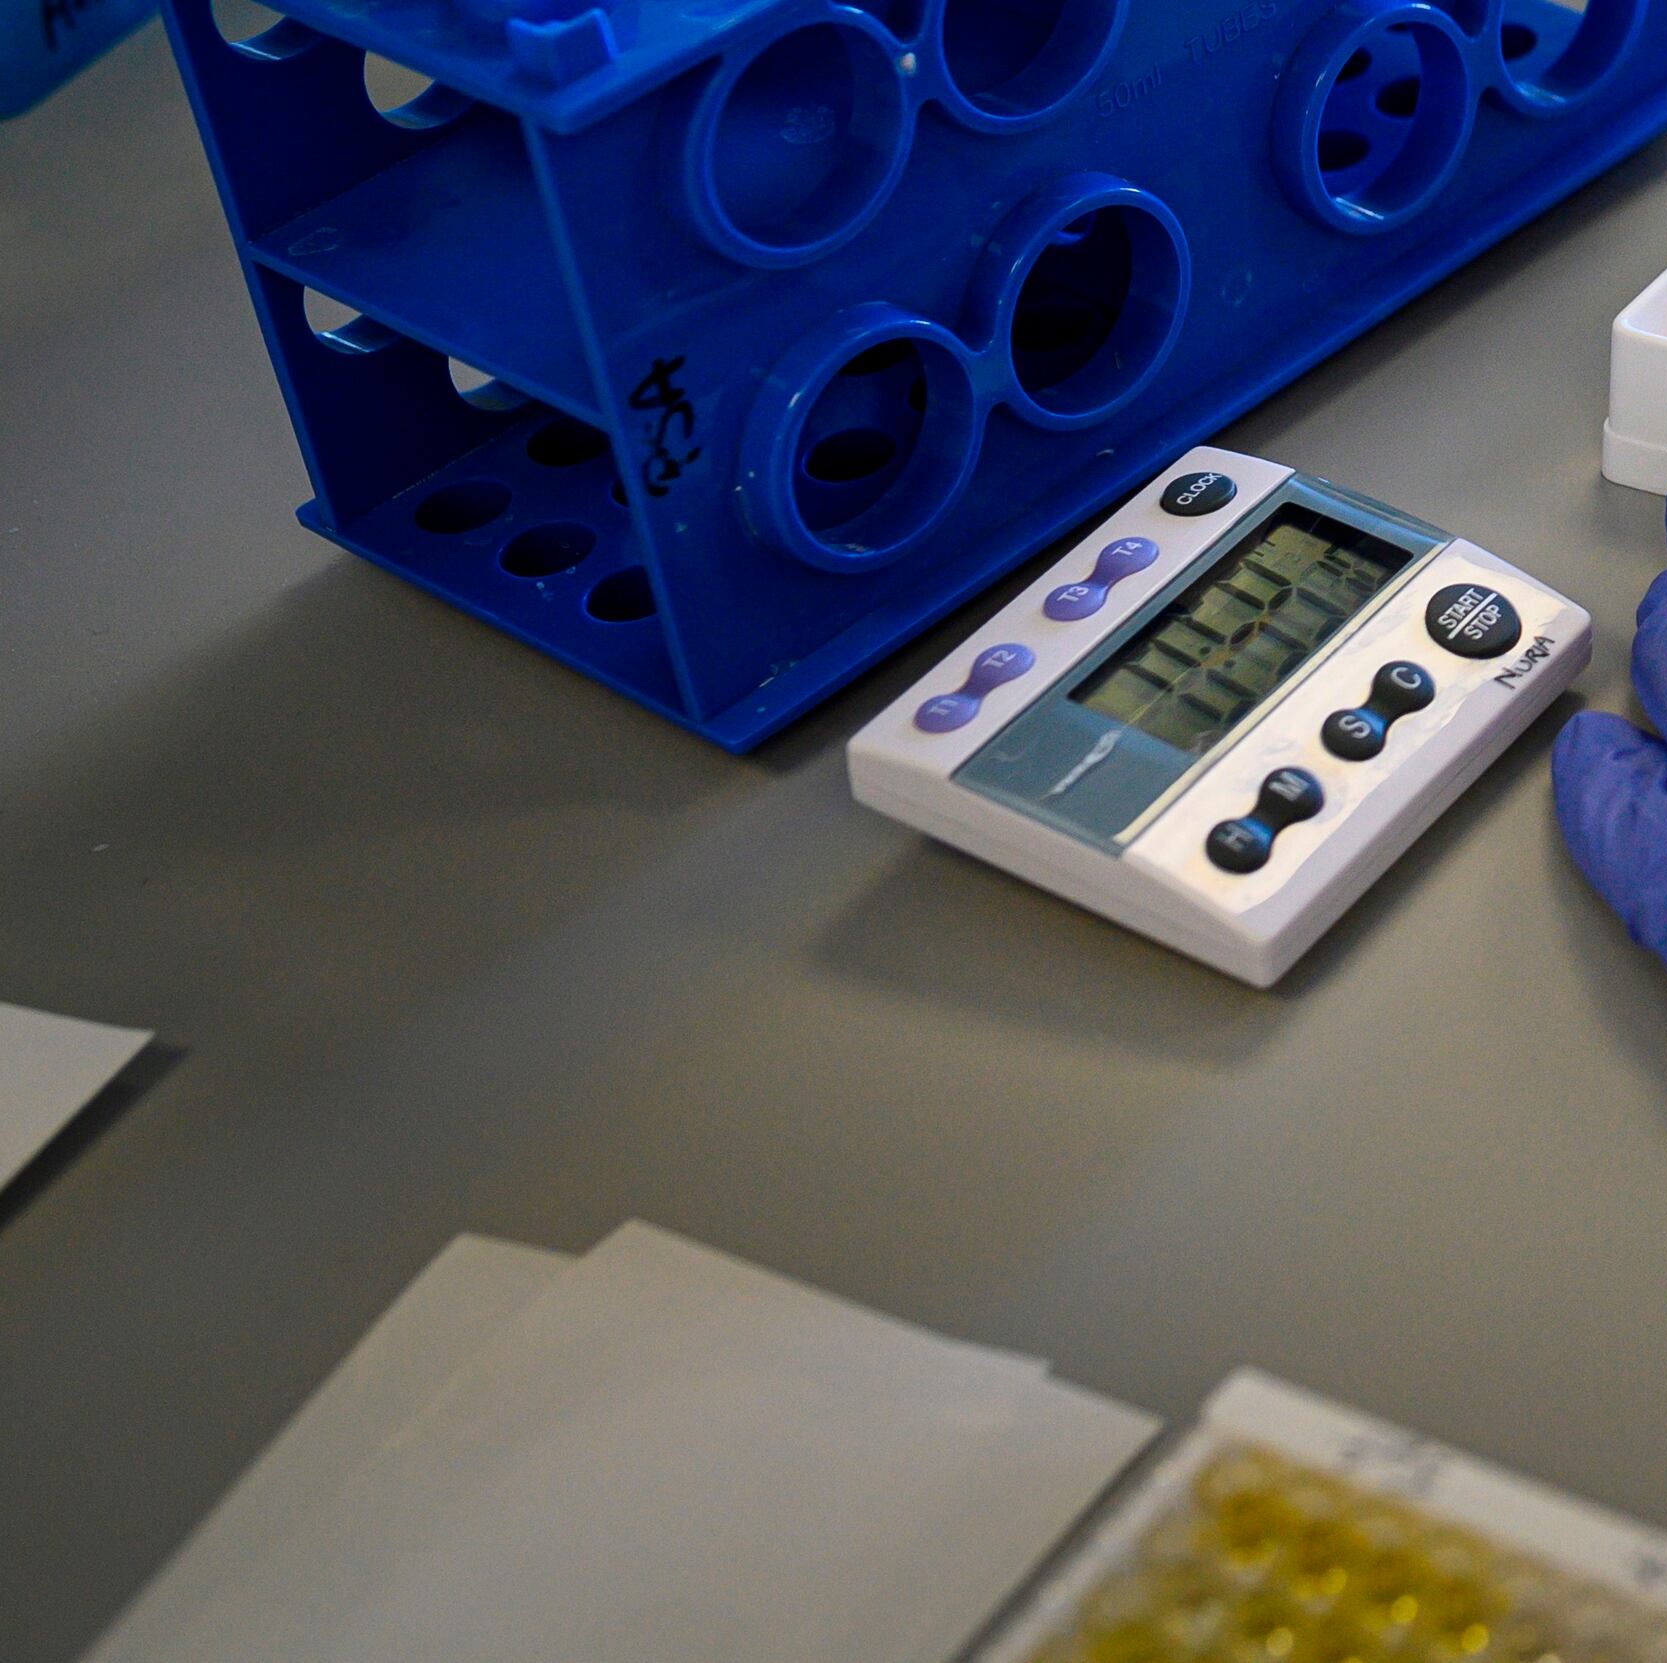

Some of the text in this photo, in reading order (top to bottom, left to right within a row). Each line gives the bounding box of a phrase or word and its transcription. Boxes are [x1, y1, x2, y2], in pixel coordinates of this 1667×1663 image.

[1184, 1, 1277, 65] TUBES
[1176, 472, 1223, 506] CLOCK
[1057, 540, 1142, 604] T3 T4
[1437, 587, 1485, 630] START
[1462, 604, 1504, 641] STOP
[928, 648, 1017, 717] T1 T2
[1337, 665, 1423, 740] S C
[1220, 770, 1309, 850] H M
